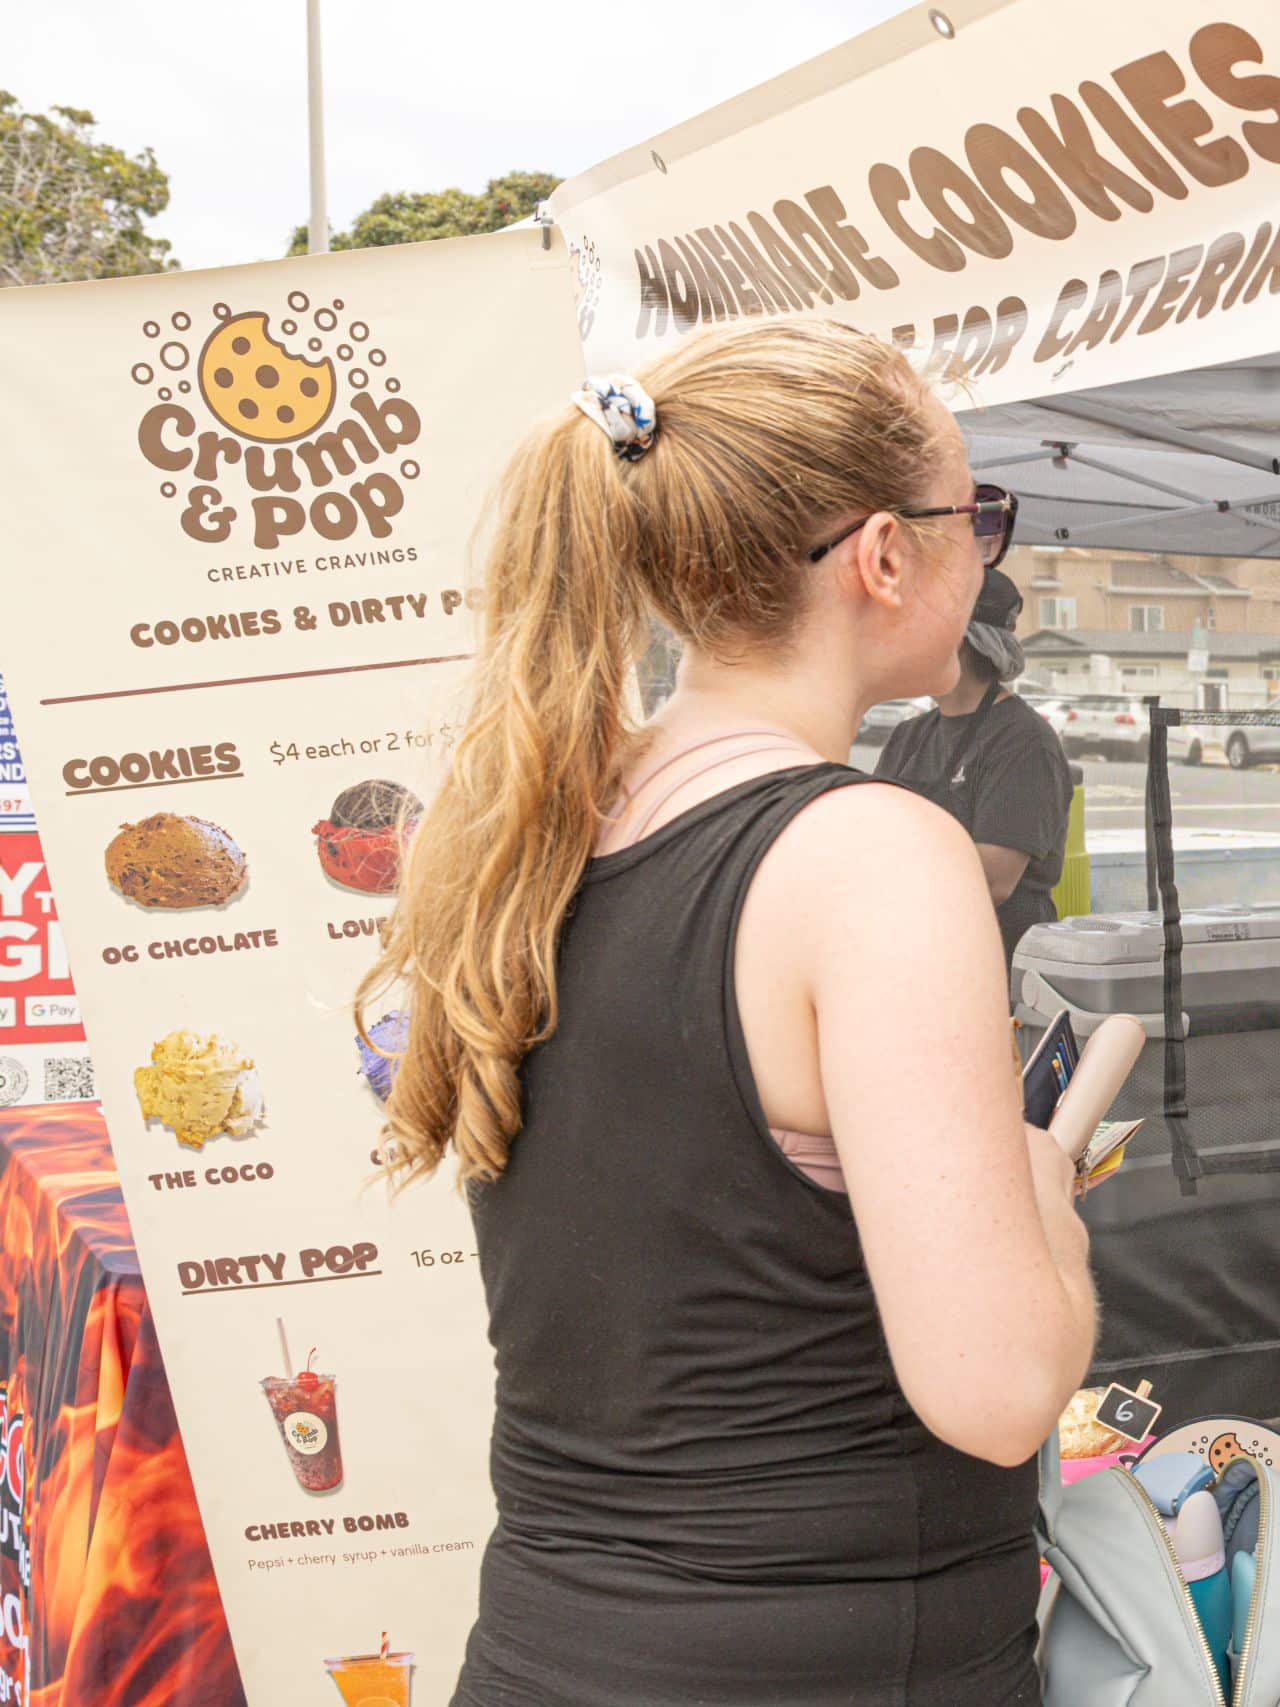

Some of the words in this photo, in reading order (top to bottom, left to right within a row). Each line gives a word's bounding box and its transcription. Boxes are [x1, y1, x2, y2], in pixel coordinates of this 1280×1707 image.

[634, 185, 899, 340] HOMEMADE
[926, 296, 1028, 384] FOR
[138, 391, 421, 492] Crumb
[181, 485, 237, 543] &
[207, 558, 308, 583] CREATIVE
[315, 547, 418, 572] CRAVINGS
[130, 609, 281, 649] COOKIES
[294, 606, 318, 630] &
[328, 592, 428, 628] DIRTY
[63, 742, 242, 789] COOKIES
[270, 741, 300, 765] $4
[305, 738, 355, 759] each
[360, 739, 381, 753] or
[386, 732, 400, 750] 2
[404, 730, 434, 748] for
[102, 944, 139, 965] OG
[147, 929, 278, 960] CHCOLATE
[50, 1004, 75, 1017] Pay
[148, 1170, 197, 1191] THE
[205, 1162, 274, 1185] COCO
[178, 1252, 287, 1289] DIRTY
[299, 1242, 378, 1277] POP
[411, 1249, 435, 1267] 16
[441, 1251, 464, 1264] oz
[244, 1518, 335, 1542] CHERRY
[343, 1512, 409, 1533] BOMB
[248, 1558, 285, 1572] Pepsi
[297, 1552, 336, 1566] cherry
[343, 1549, 377, 1564] syrup
[390, 1543, 429, 1558] vanilla
[432, 1539, 474, 1553] cream
